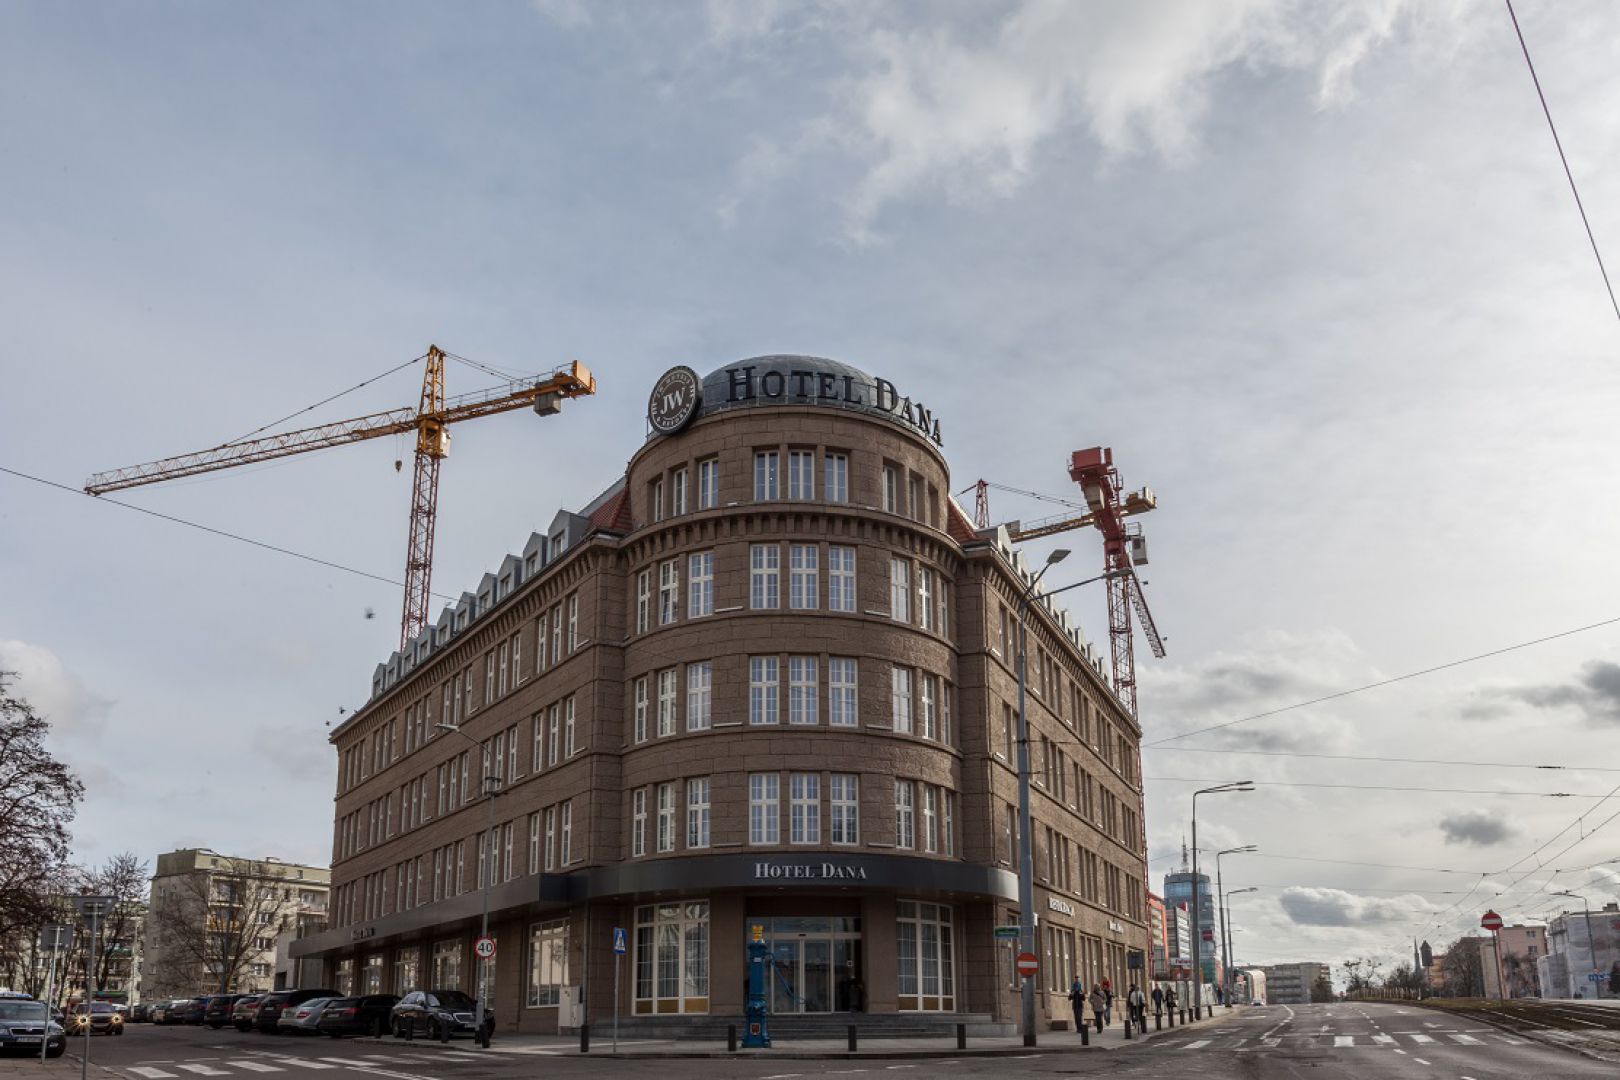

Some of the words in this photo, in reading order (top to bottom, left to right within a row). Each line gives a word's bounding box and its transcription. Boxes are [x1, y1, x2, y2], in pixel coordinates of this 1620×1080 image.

[661, 387, 685, 414] JW
[726, 366, 861, 404] HOTEL
[874, 376, 943, 447] DANA
[755, 862, 815, 878] HOTEL
[821, 862, 866, 879] DANA
[478, 942, 493, 953] 40
